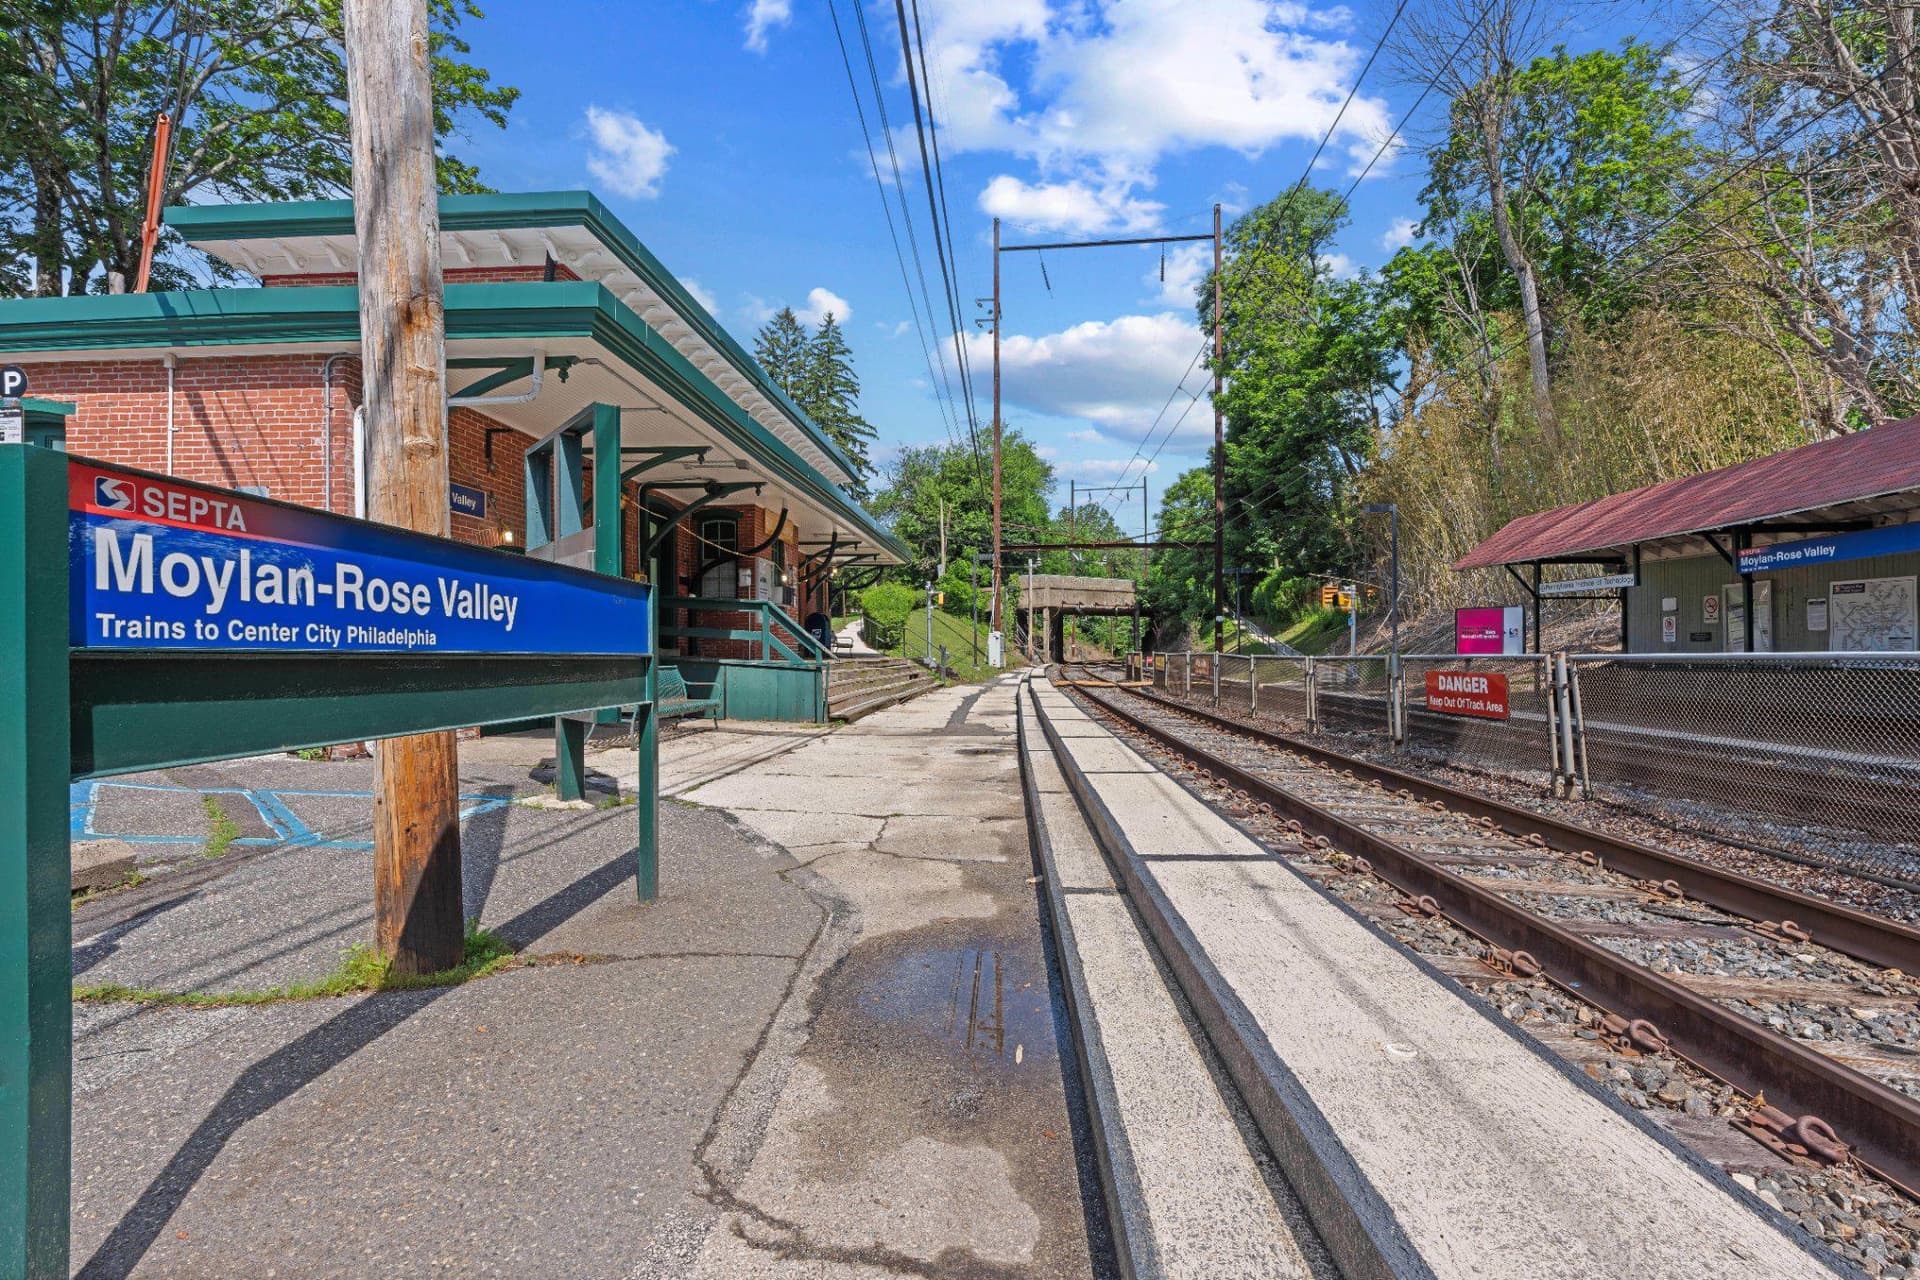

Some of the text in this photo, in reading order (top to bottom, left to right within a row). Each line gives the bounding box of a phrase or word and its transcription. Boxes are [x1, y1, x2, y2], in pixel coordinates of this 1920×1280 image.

[4, 371, 21, 394] P
[143, 487, 246, 532] SEPTA
[452, 492, 476, 510] Valley
[1740, 545, 1836, 566] Moylan-Rose Valley
[96, 527, 518, 632] Moylan-Rose Valley
[96, 613, 437, 648] Trains to Center City Philadelphia
[1438, 675, 1489, 694] DANGER
[1444, 696, 1456, 708] Out
[1465, 698, 1485, 711] Track
[1486, 701, 1504, 713] Area
